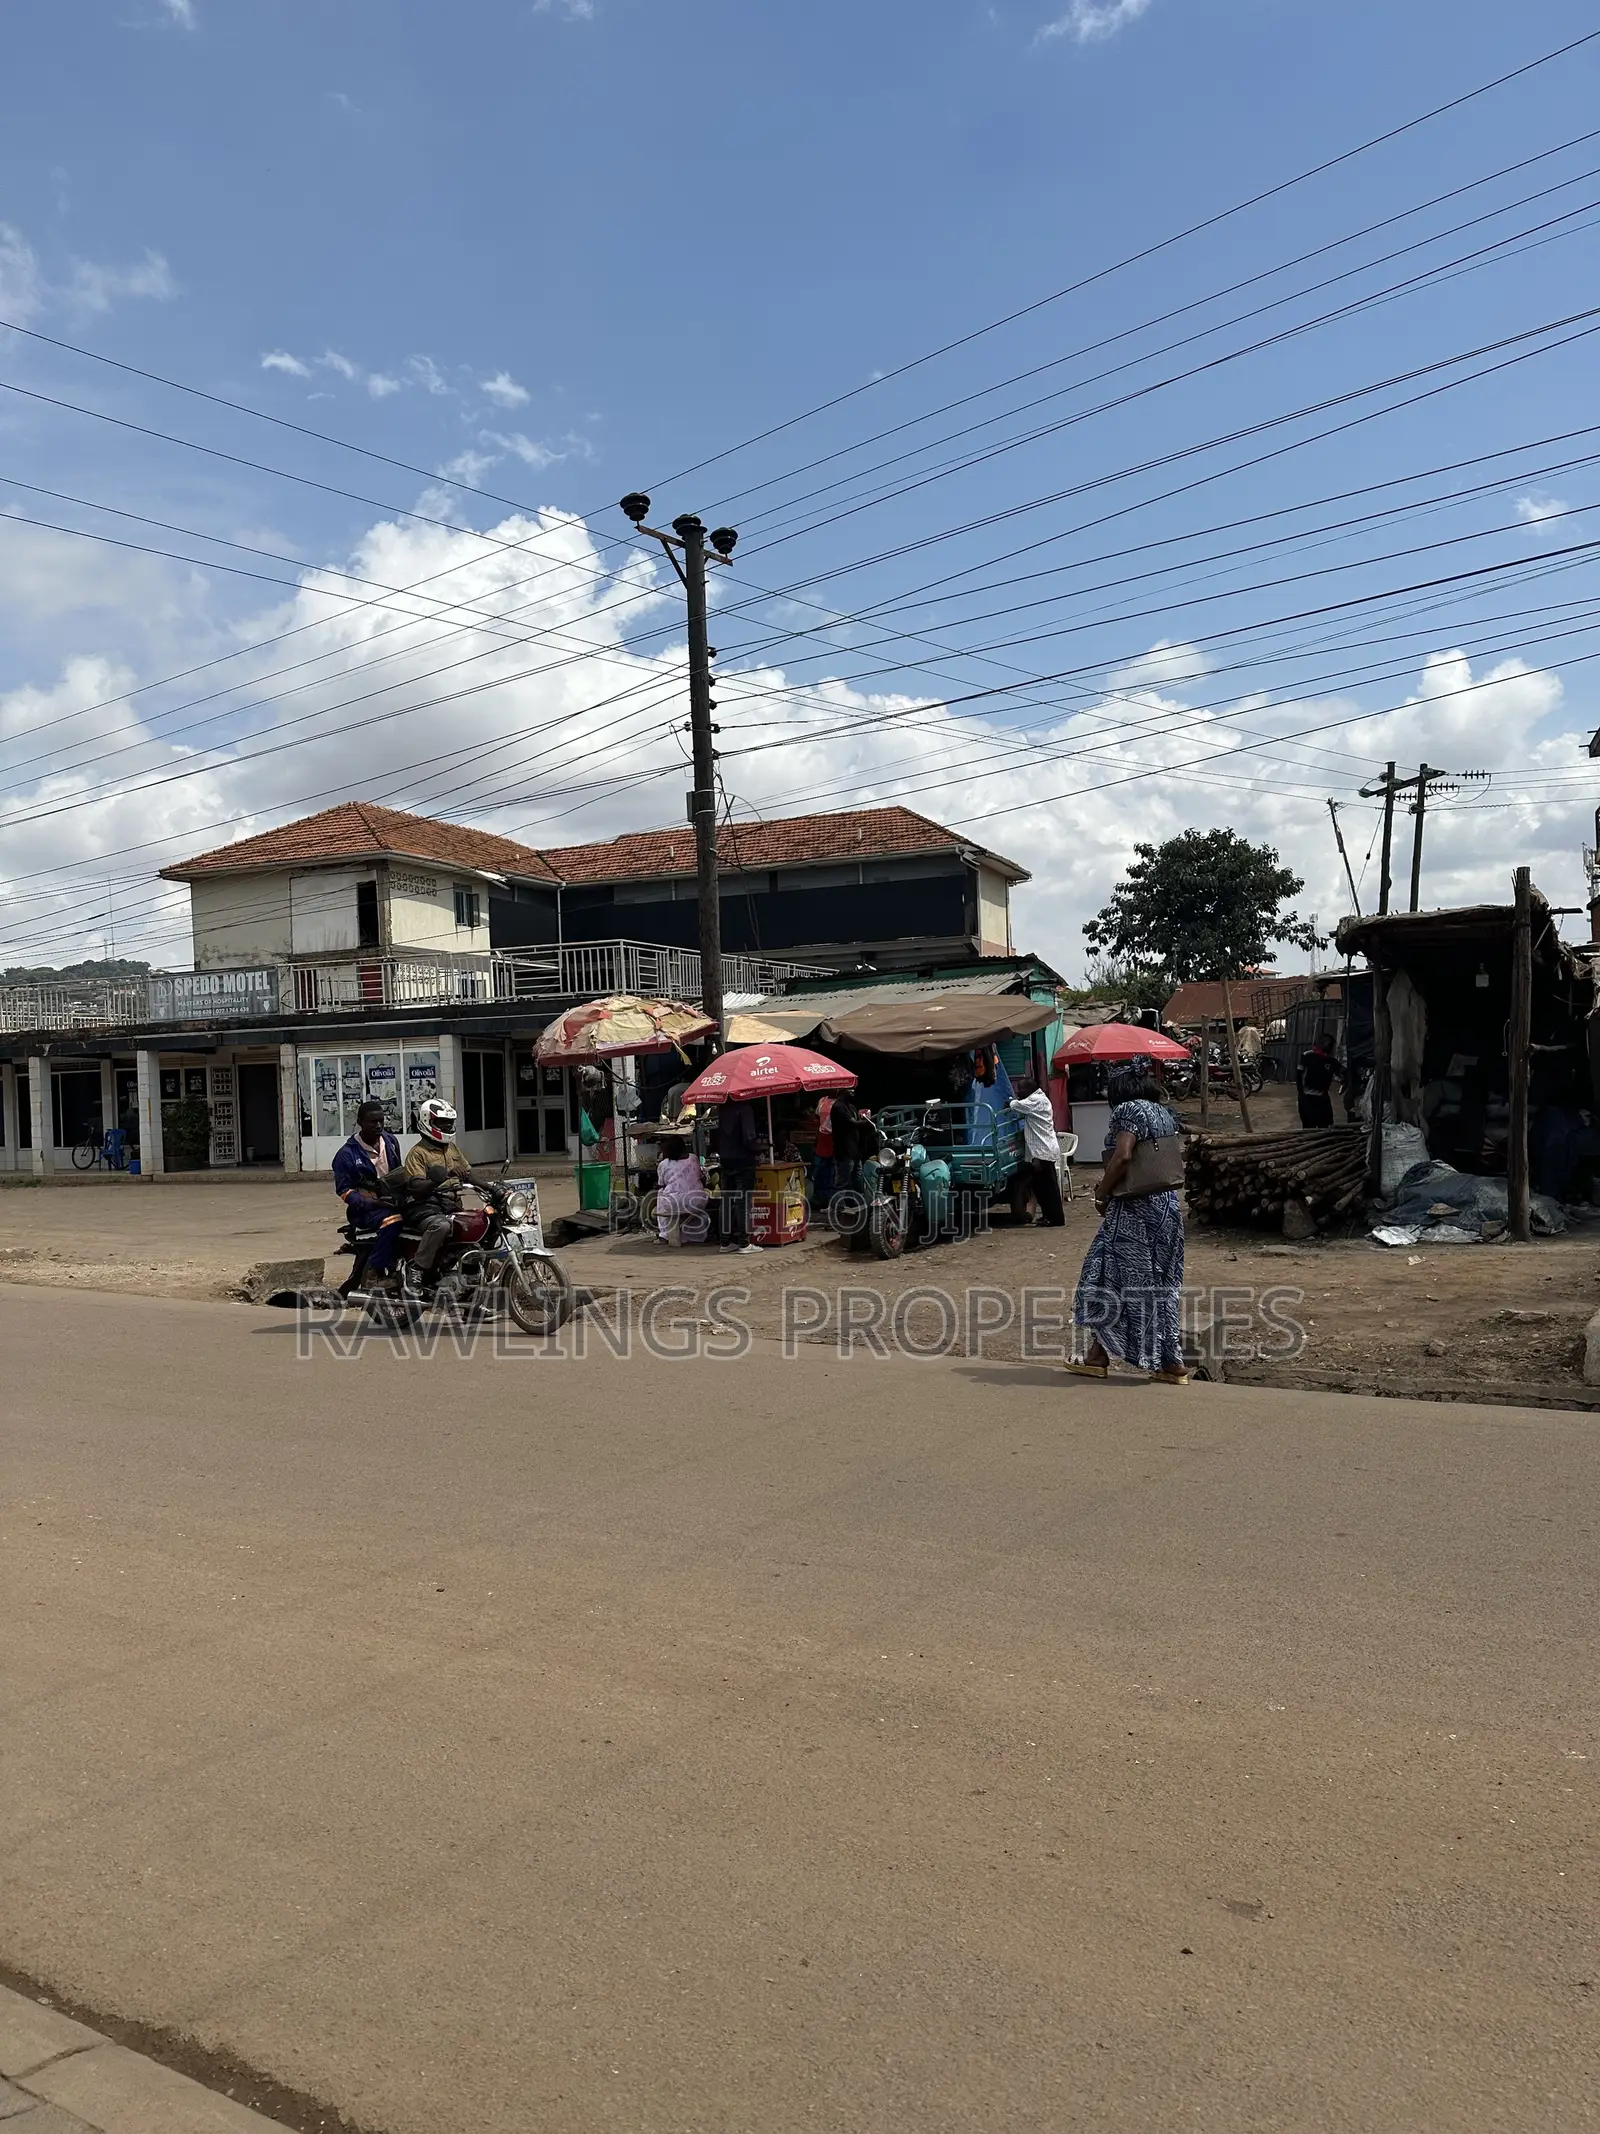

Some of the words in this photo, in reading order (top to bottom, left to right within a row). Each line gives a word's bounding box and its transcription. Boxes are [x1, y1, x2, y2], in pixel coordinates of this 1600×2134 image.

[174, 975, 220, 997] SPEDO
[223, 971, 270, 993] MOTEL
[750, 1066, 779, 1077] airtel
